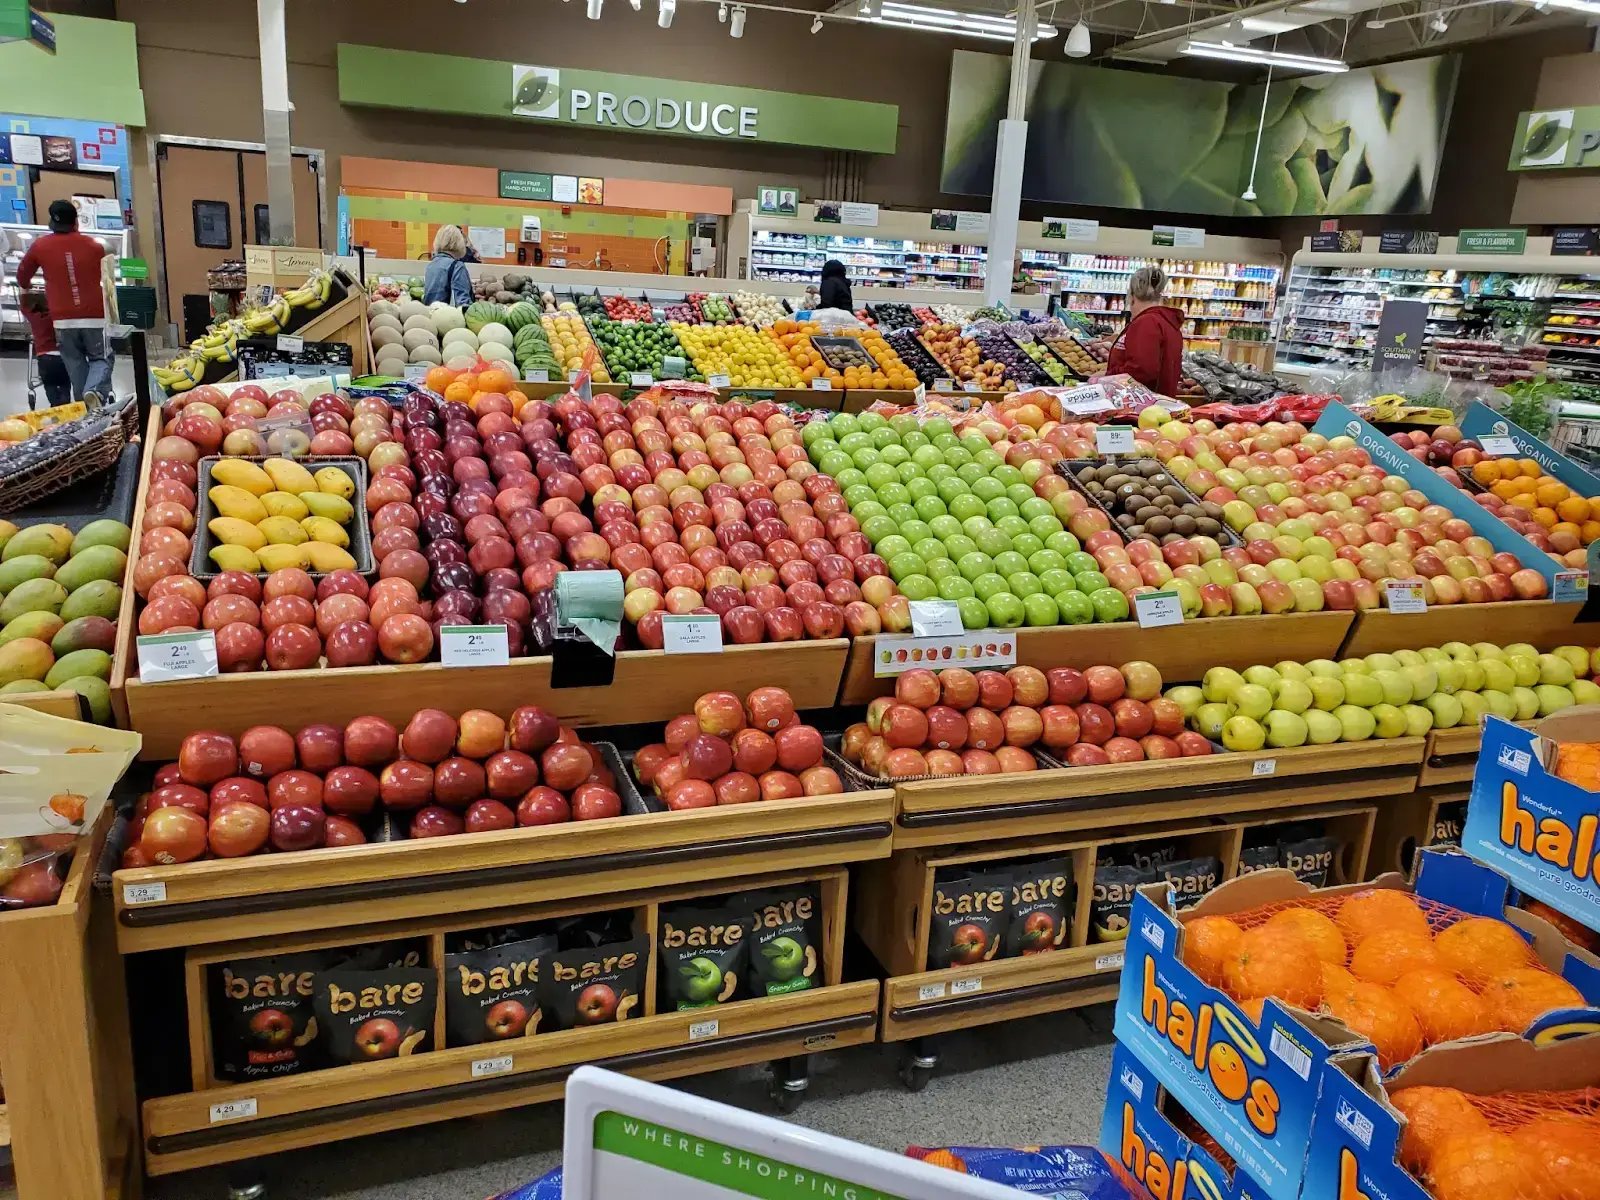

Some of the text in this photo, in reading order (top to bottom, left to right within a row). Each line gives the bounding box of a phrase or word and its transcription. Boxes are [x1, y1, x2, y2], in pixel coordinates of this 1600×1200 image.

[571, 89, 758, 138] PRODUCE
[1466, 237, 1482, 246] FRESH
[1487, 237, 1515, 246] FLAVORFUL
[1381, 345, 1417, 355] SOUTHERN
[1383, 352, 1411, 360] GROWN
[1363, 436, 1409, 474] ORGANIC
[1511, 436, 1559, 472] ORGANIC
[1523, 794, 1558, 816] Wonderful
[1501, 780, 1600, 881] hal
[1286, 850, 1332, 872] bare
[1539, 869, 1562, 887] pure
[934, 889, 1005, 915] bare
[948, 915, 992, 927] Baked Crunchy
[664, 922, 743, 949] bare
[759, 925, 804, 944] Baked Crunchy
[679, 947, 728, 961] Baked Crunchy
[553, 952, 638, 982] bare
[223, 967, 315, 1000] bare
[570, 973, 621, 992] Baked Crunchy
[242, 999, 300, 1012] Baked Crunchy
[327, 981, 423, 1014] bare
[480, 989, 534, 1008] Baked Crunchy
[350, 1010, 406, 1025] Baked Crunchy
[1142, 953, 1280, 1141] halos
[1273, 1020, 1313, 1058] halosfun.com
[243, 1060, 299, 1080] Apple Chips
[1169, 1053, 1187, 1075] pure
[1187, 1068, 1223, 1112] goodness
[623, 1121, 857, 1200] WHERE SHOPPING
[1005, 1166, 1018, 1178] NET
